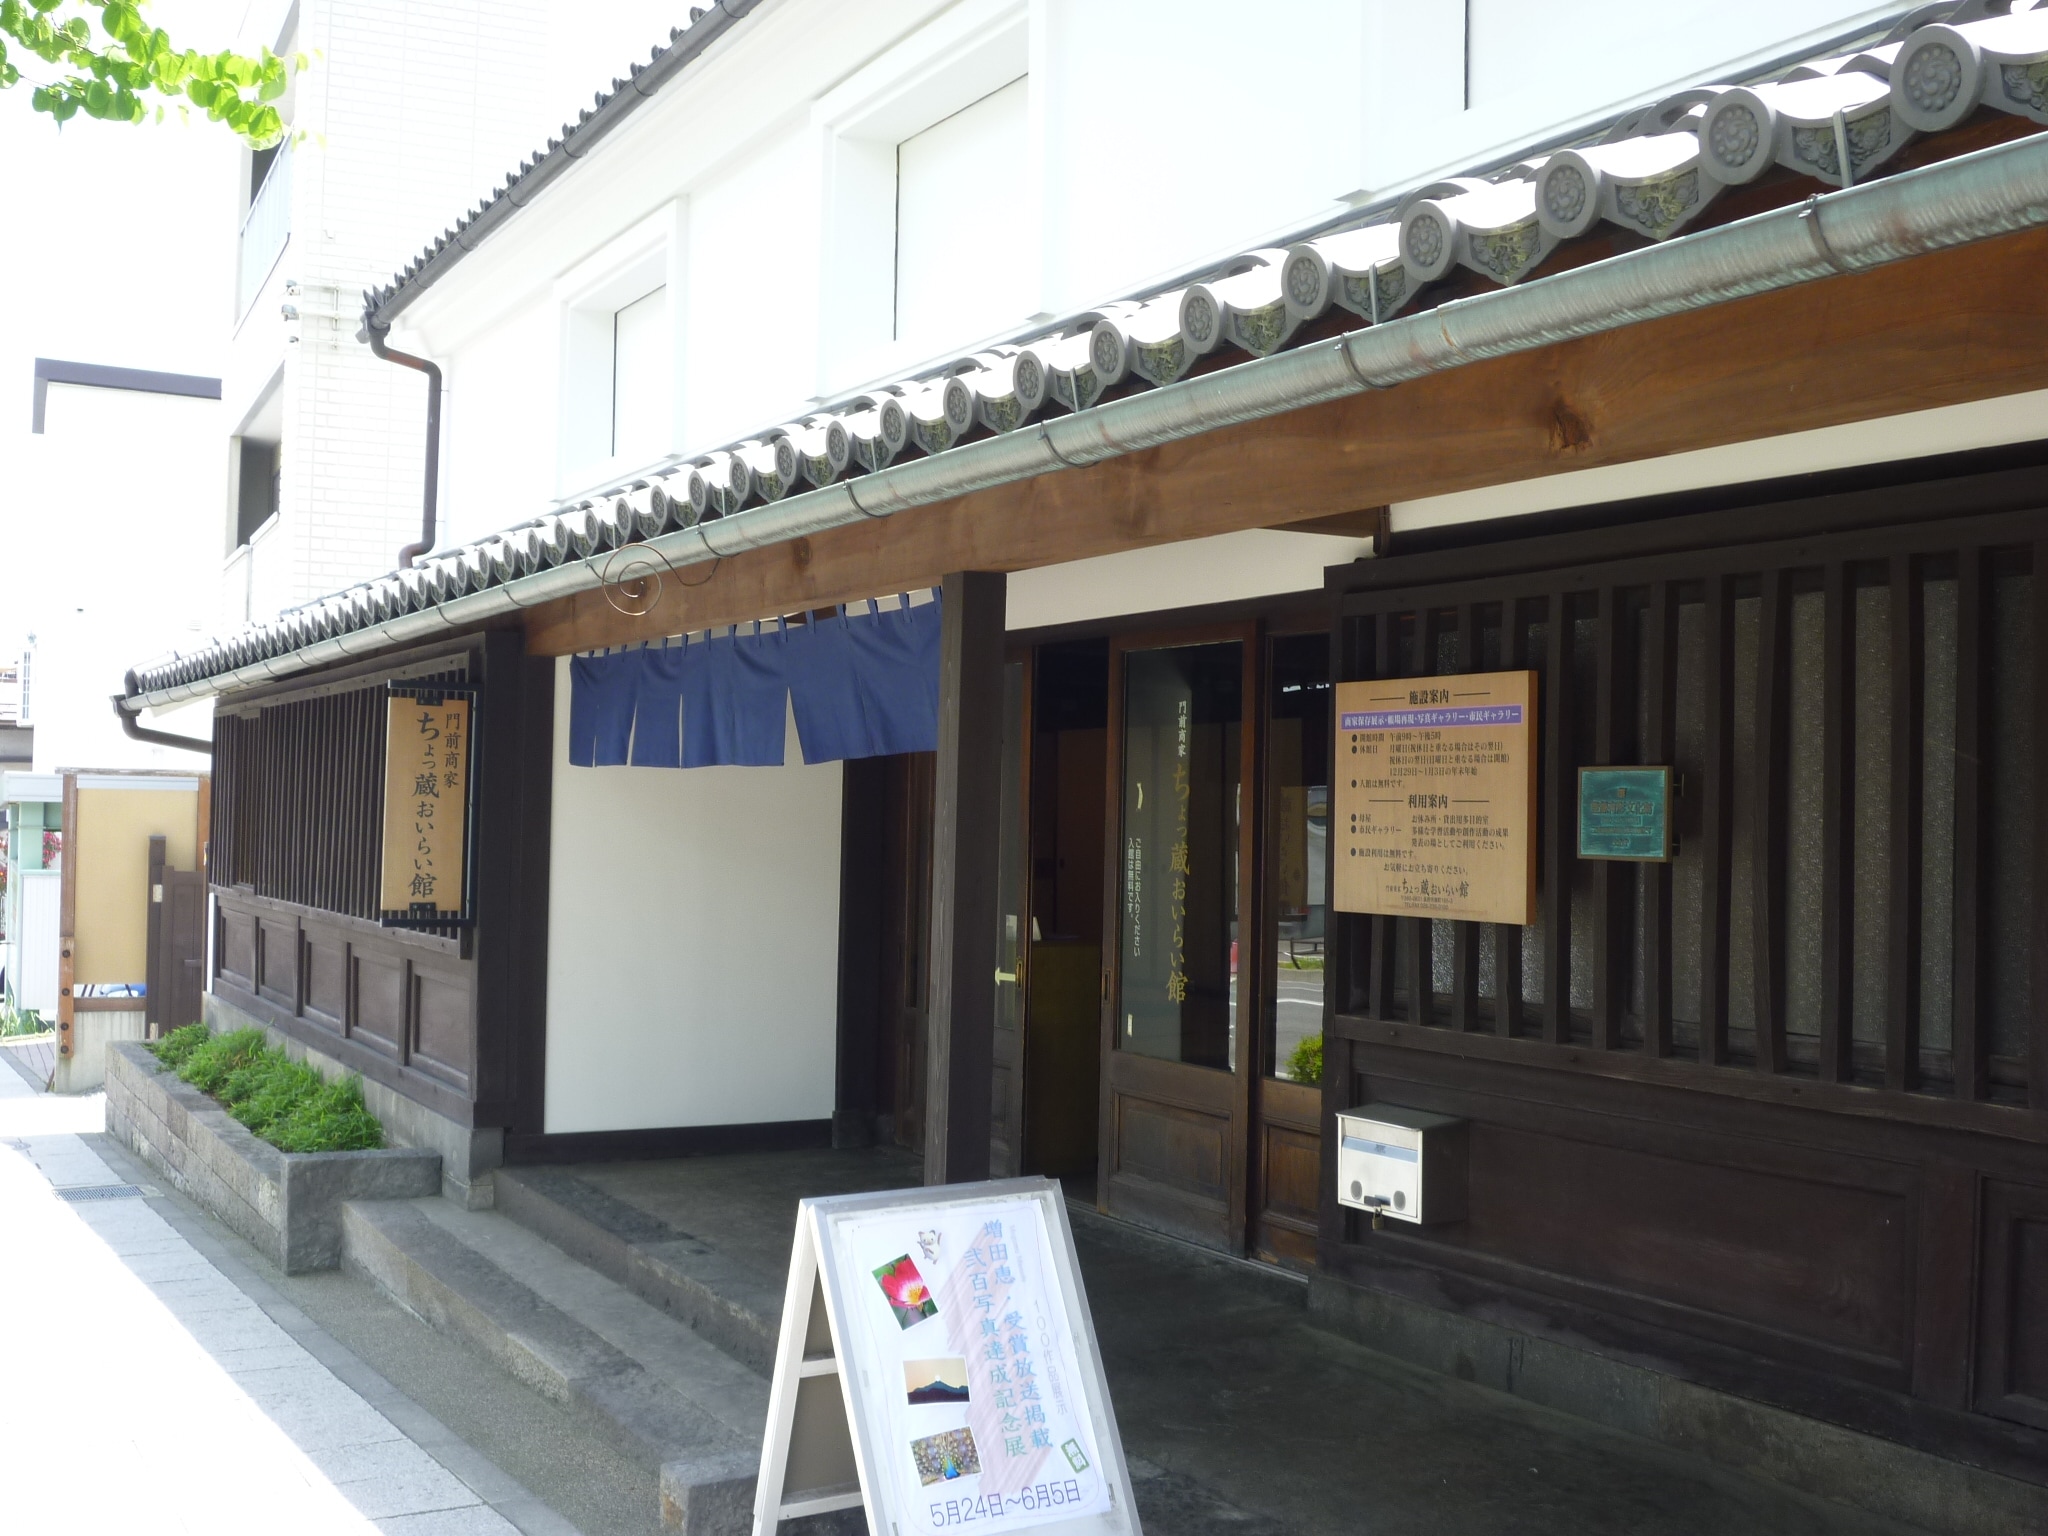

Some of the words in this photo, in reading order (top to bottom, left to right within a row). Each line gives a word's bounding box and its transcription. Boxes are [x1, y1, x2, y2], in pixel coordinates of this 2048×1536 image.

[1409, 689, 1449, 705] 施設案内
[443, 713, 462, 789] 門前商家
[1177, 701, 1187, 757] 門前商家
[408, 711, 440, 899] ちょっ蔵おいらい館
[1408, 794, 1449, 809] 利用案内
[1359, 825, 1402, 835] 市民ギャラリー
[1133, 838, 1142, 957] ご自由にお入りください
[1165, 762, 1191, 1004] ちょっ蔵おいらい館
[1402, 878, 1470, 899] ちょっ蔵おいらい館
[929, 1477, 1082, 1529] 5月24日～6月5日
